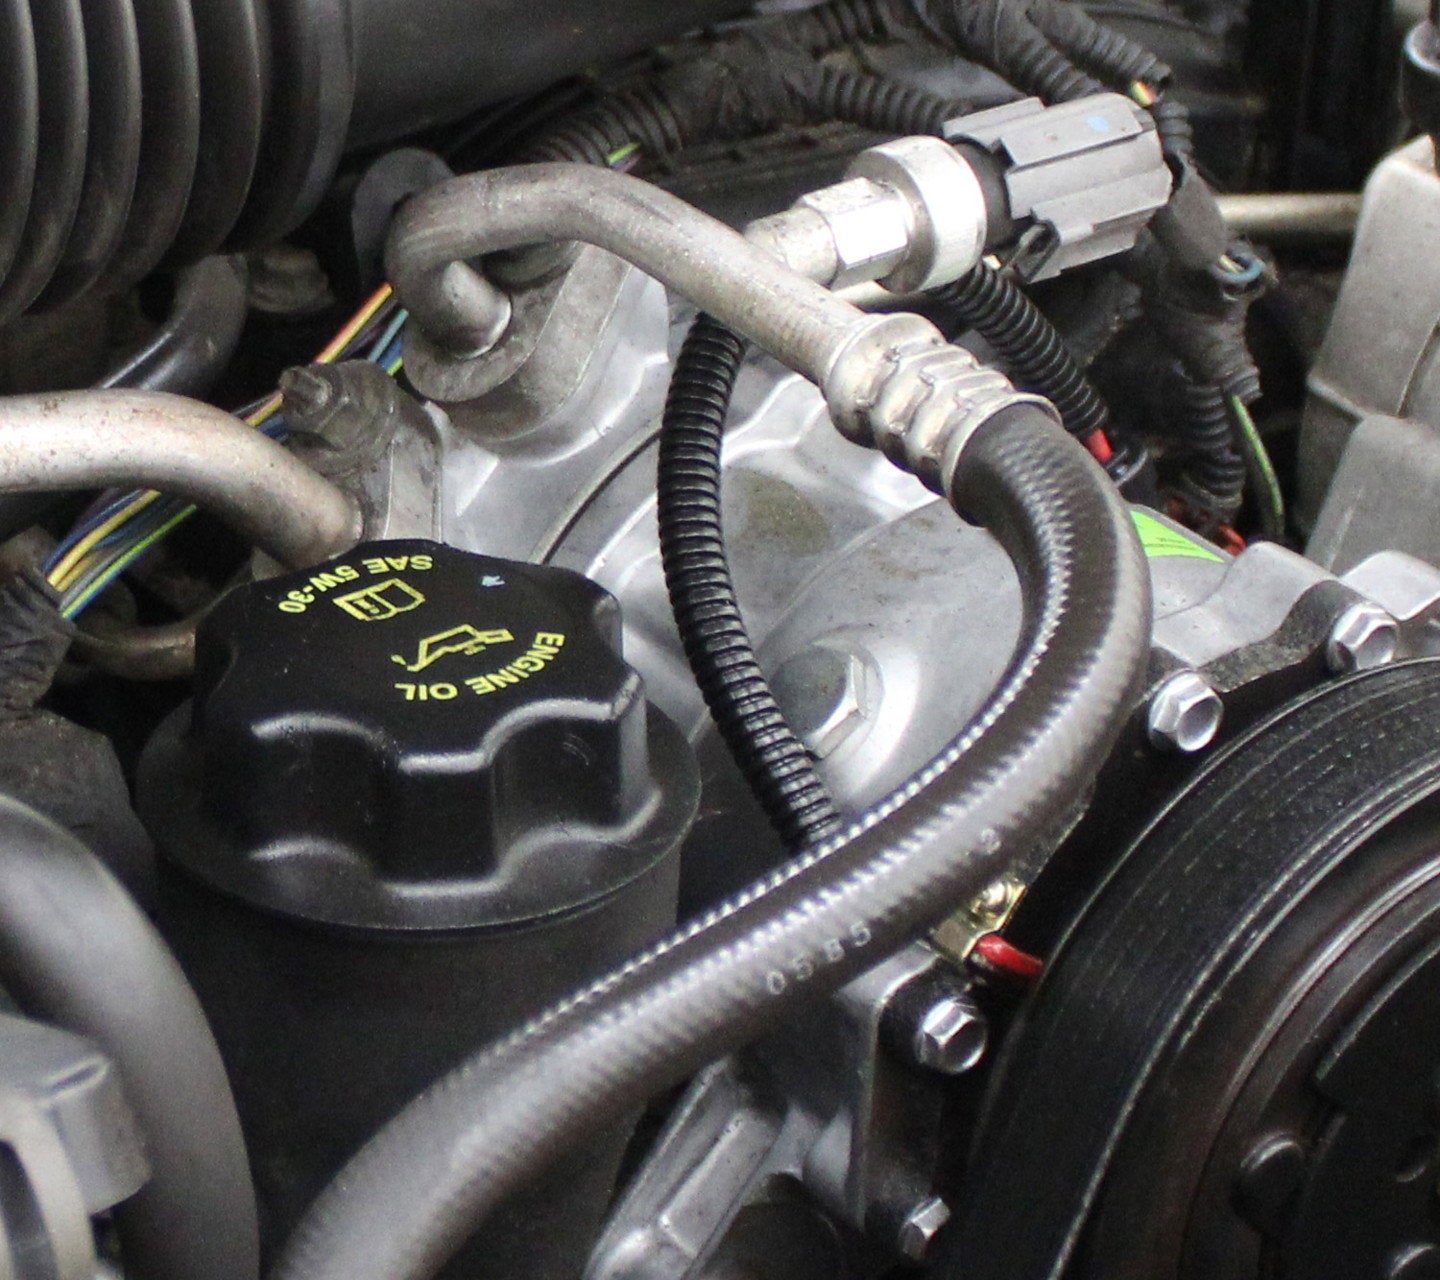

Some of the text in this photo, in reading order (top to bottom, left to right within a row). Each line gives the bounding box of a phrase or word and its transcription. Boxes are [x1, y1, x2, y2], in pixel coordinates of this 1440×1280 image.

[277, 554, 434, 614] SAE 5W-30
[394, 630, 566, 701] ENGINE OIL
